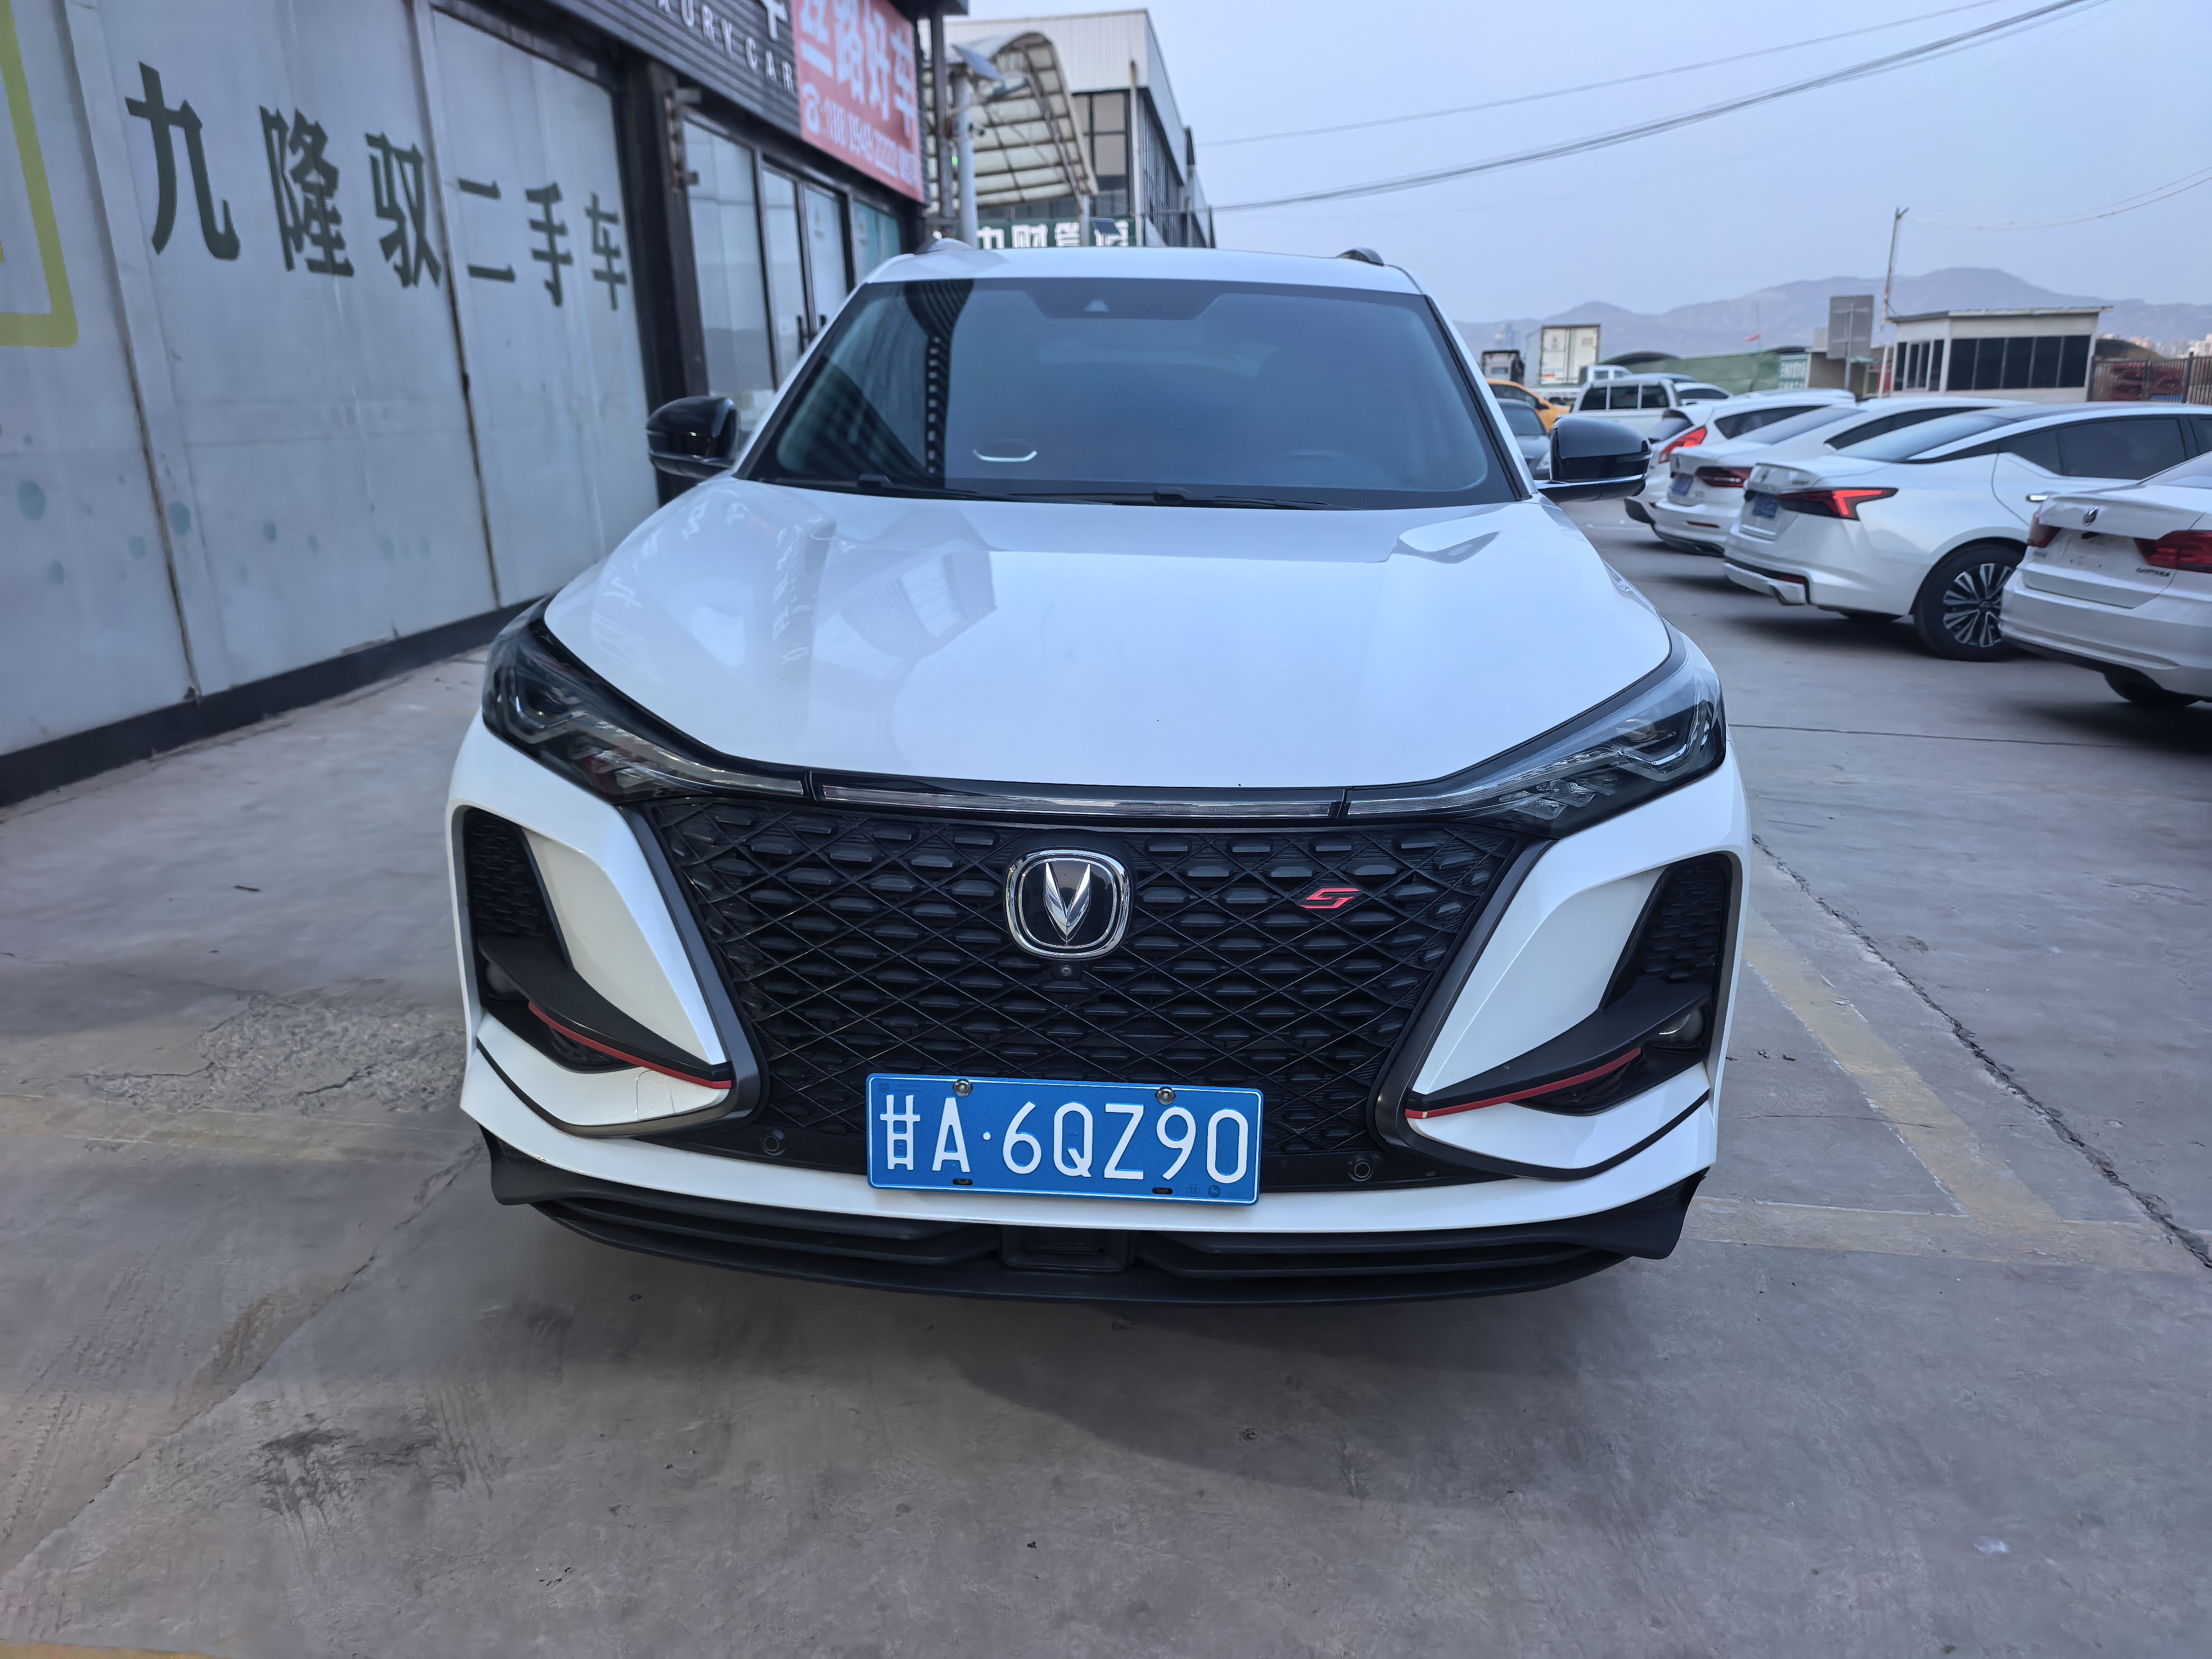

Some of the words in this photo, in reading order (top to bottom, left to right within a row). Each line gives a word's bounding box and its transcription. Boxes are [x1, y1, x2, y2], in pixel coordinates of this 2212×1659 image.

[745, 36, 795, 95] CAR
[125, 60, 628, 311] 九隆驭二手车
[880, 1094, 1249, 1184] 甘A·6QZ90
